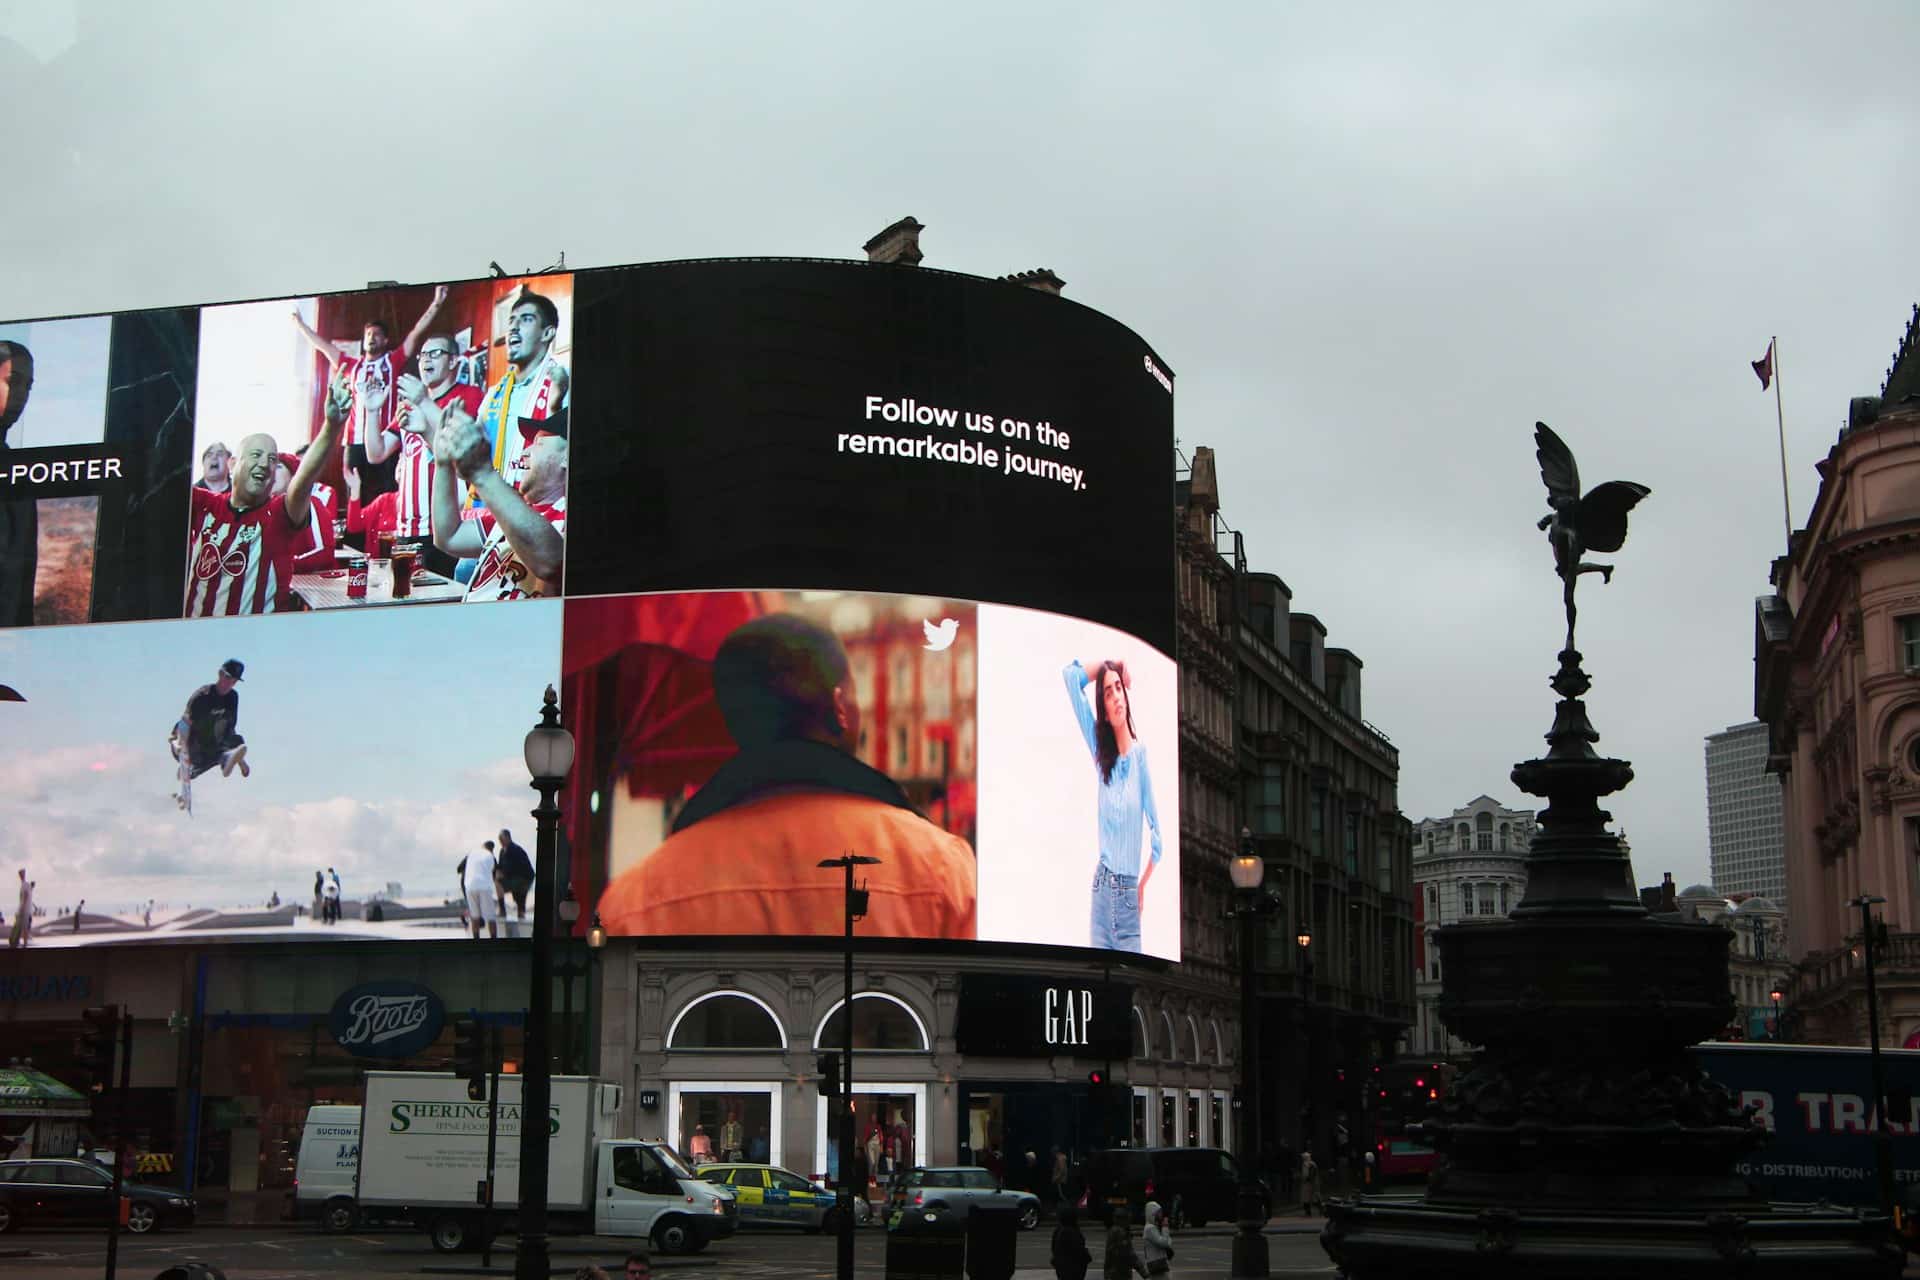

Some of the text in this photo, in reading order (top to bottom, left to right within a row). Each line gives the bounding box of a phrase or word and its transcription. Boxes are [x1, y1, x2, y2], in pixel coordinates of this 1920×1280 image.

[865, 396, 1071, 450] Follow us on the
[837, 433, 1087, 491] remarkable journey.
[339, 995, 429, 1044] Boots
[1045, 987, 1092, 1045] GAP
[317, 1128, 351, 1136] SUCTION
[389, 1104, 560, 1135] SHERINGHAS
[1763, 1162, 1864, 1180] DISTRIBUTION
